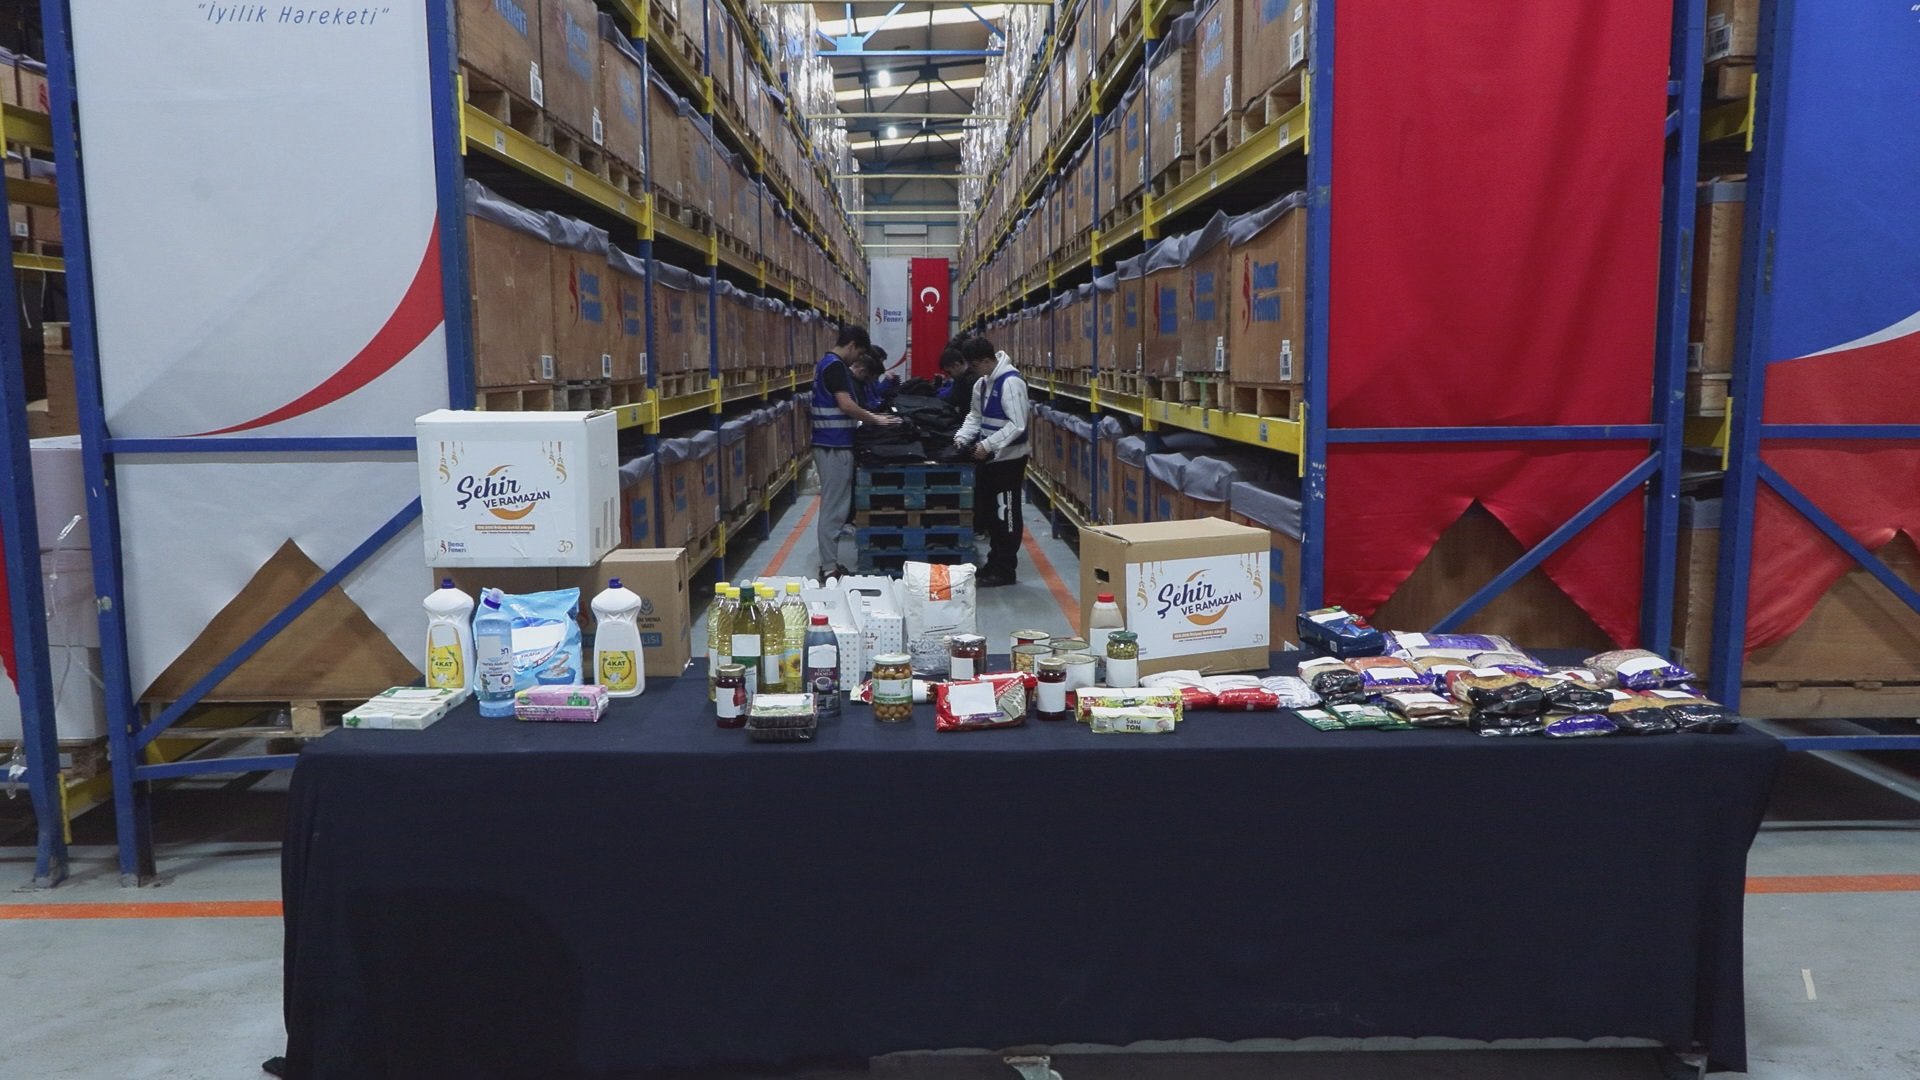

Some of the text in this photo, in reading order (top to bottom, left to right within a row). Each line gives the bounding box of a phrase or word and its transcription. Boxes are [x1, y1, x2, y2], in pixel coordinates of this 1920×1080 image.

[457, 475, 521, 509] Şehir
[483, 490, 551, 508] VE RAMAZAN
[1157, 581, 1216, 619] Şehir
[1181, 592, 1242, 616] VE RAMAZAN
